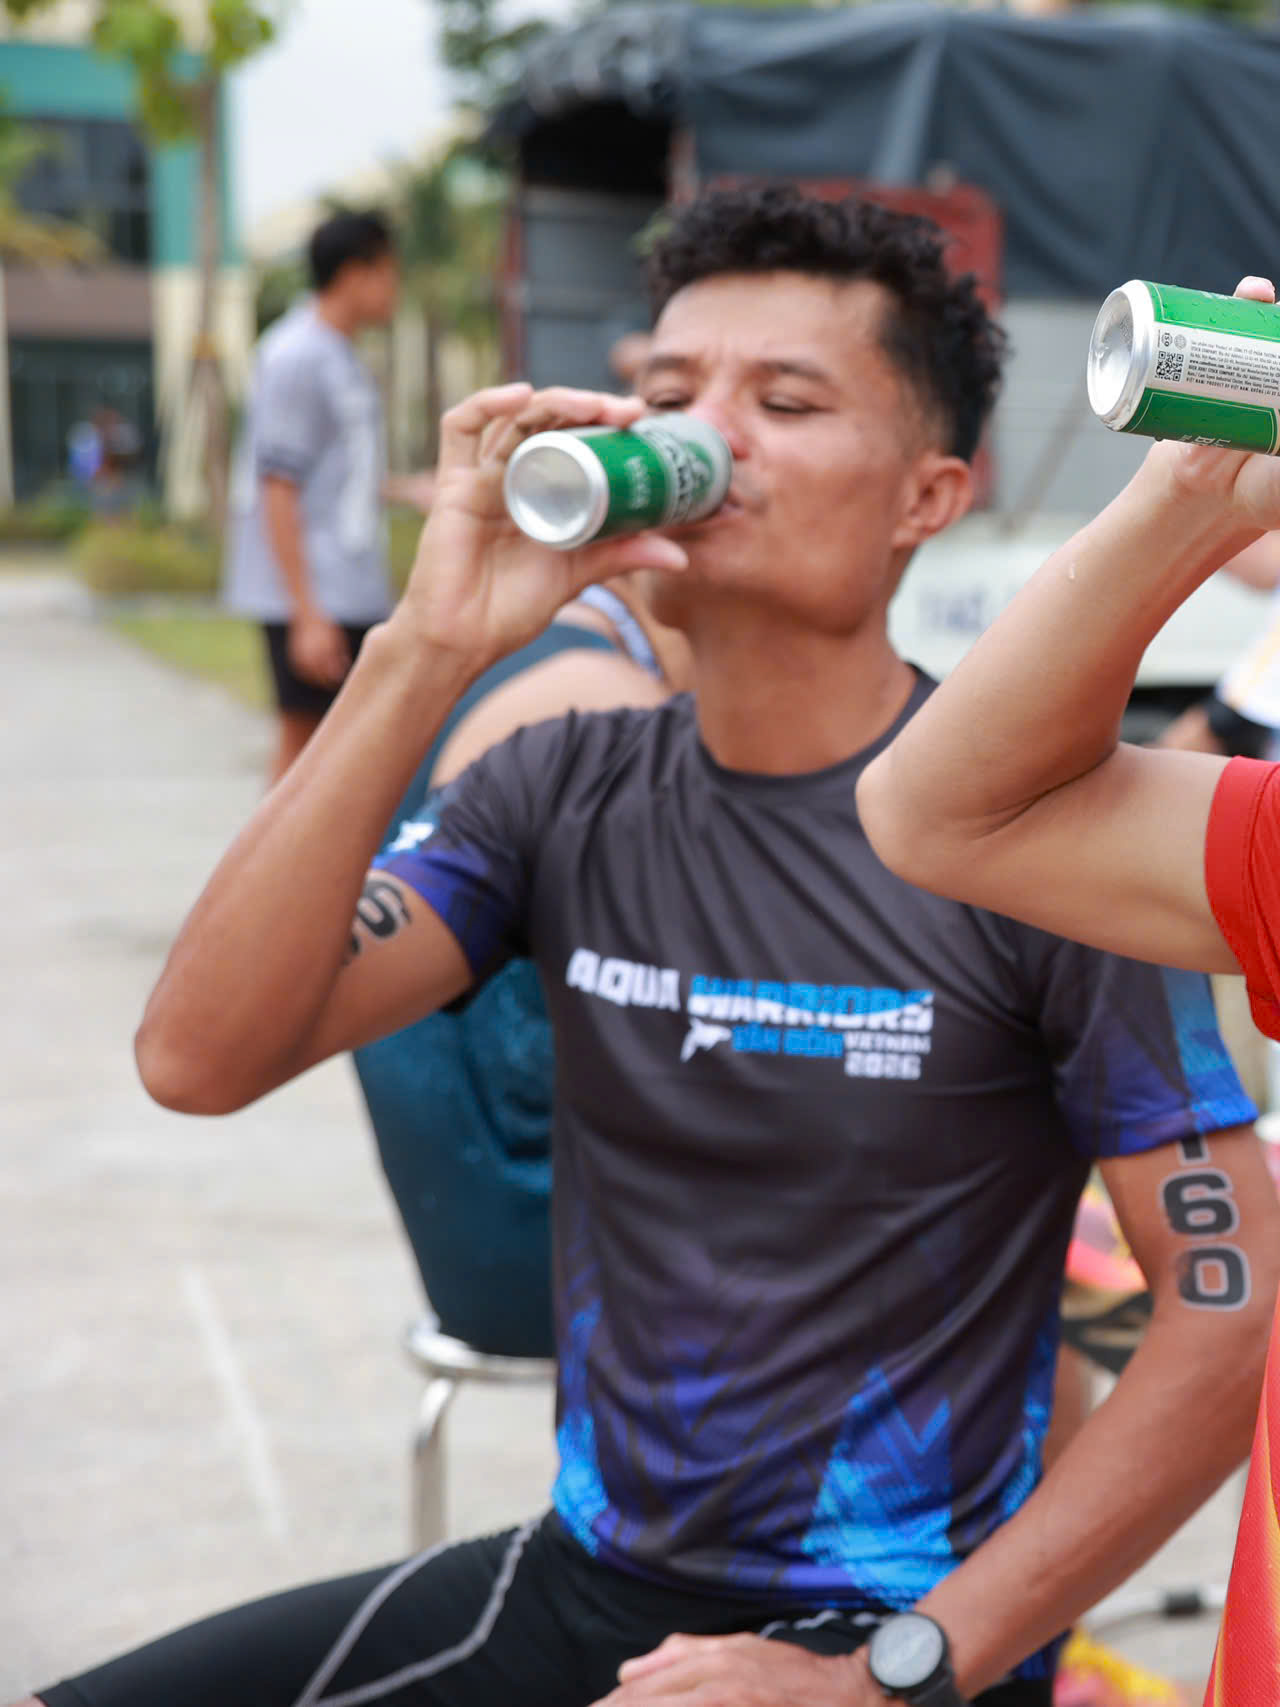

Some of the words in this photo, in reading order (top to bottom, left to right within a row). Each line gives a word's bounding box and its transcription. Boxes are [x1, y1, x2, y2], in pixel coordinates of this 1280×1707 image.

[1163, 332, 1171, 347] ISO
[566, 947, 681, 1012] AQUA
[687, 974, 935, 1033] WARRIORS
